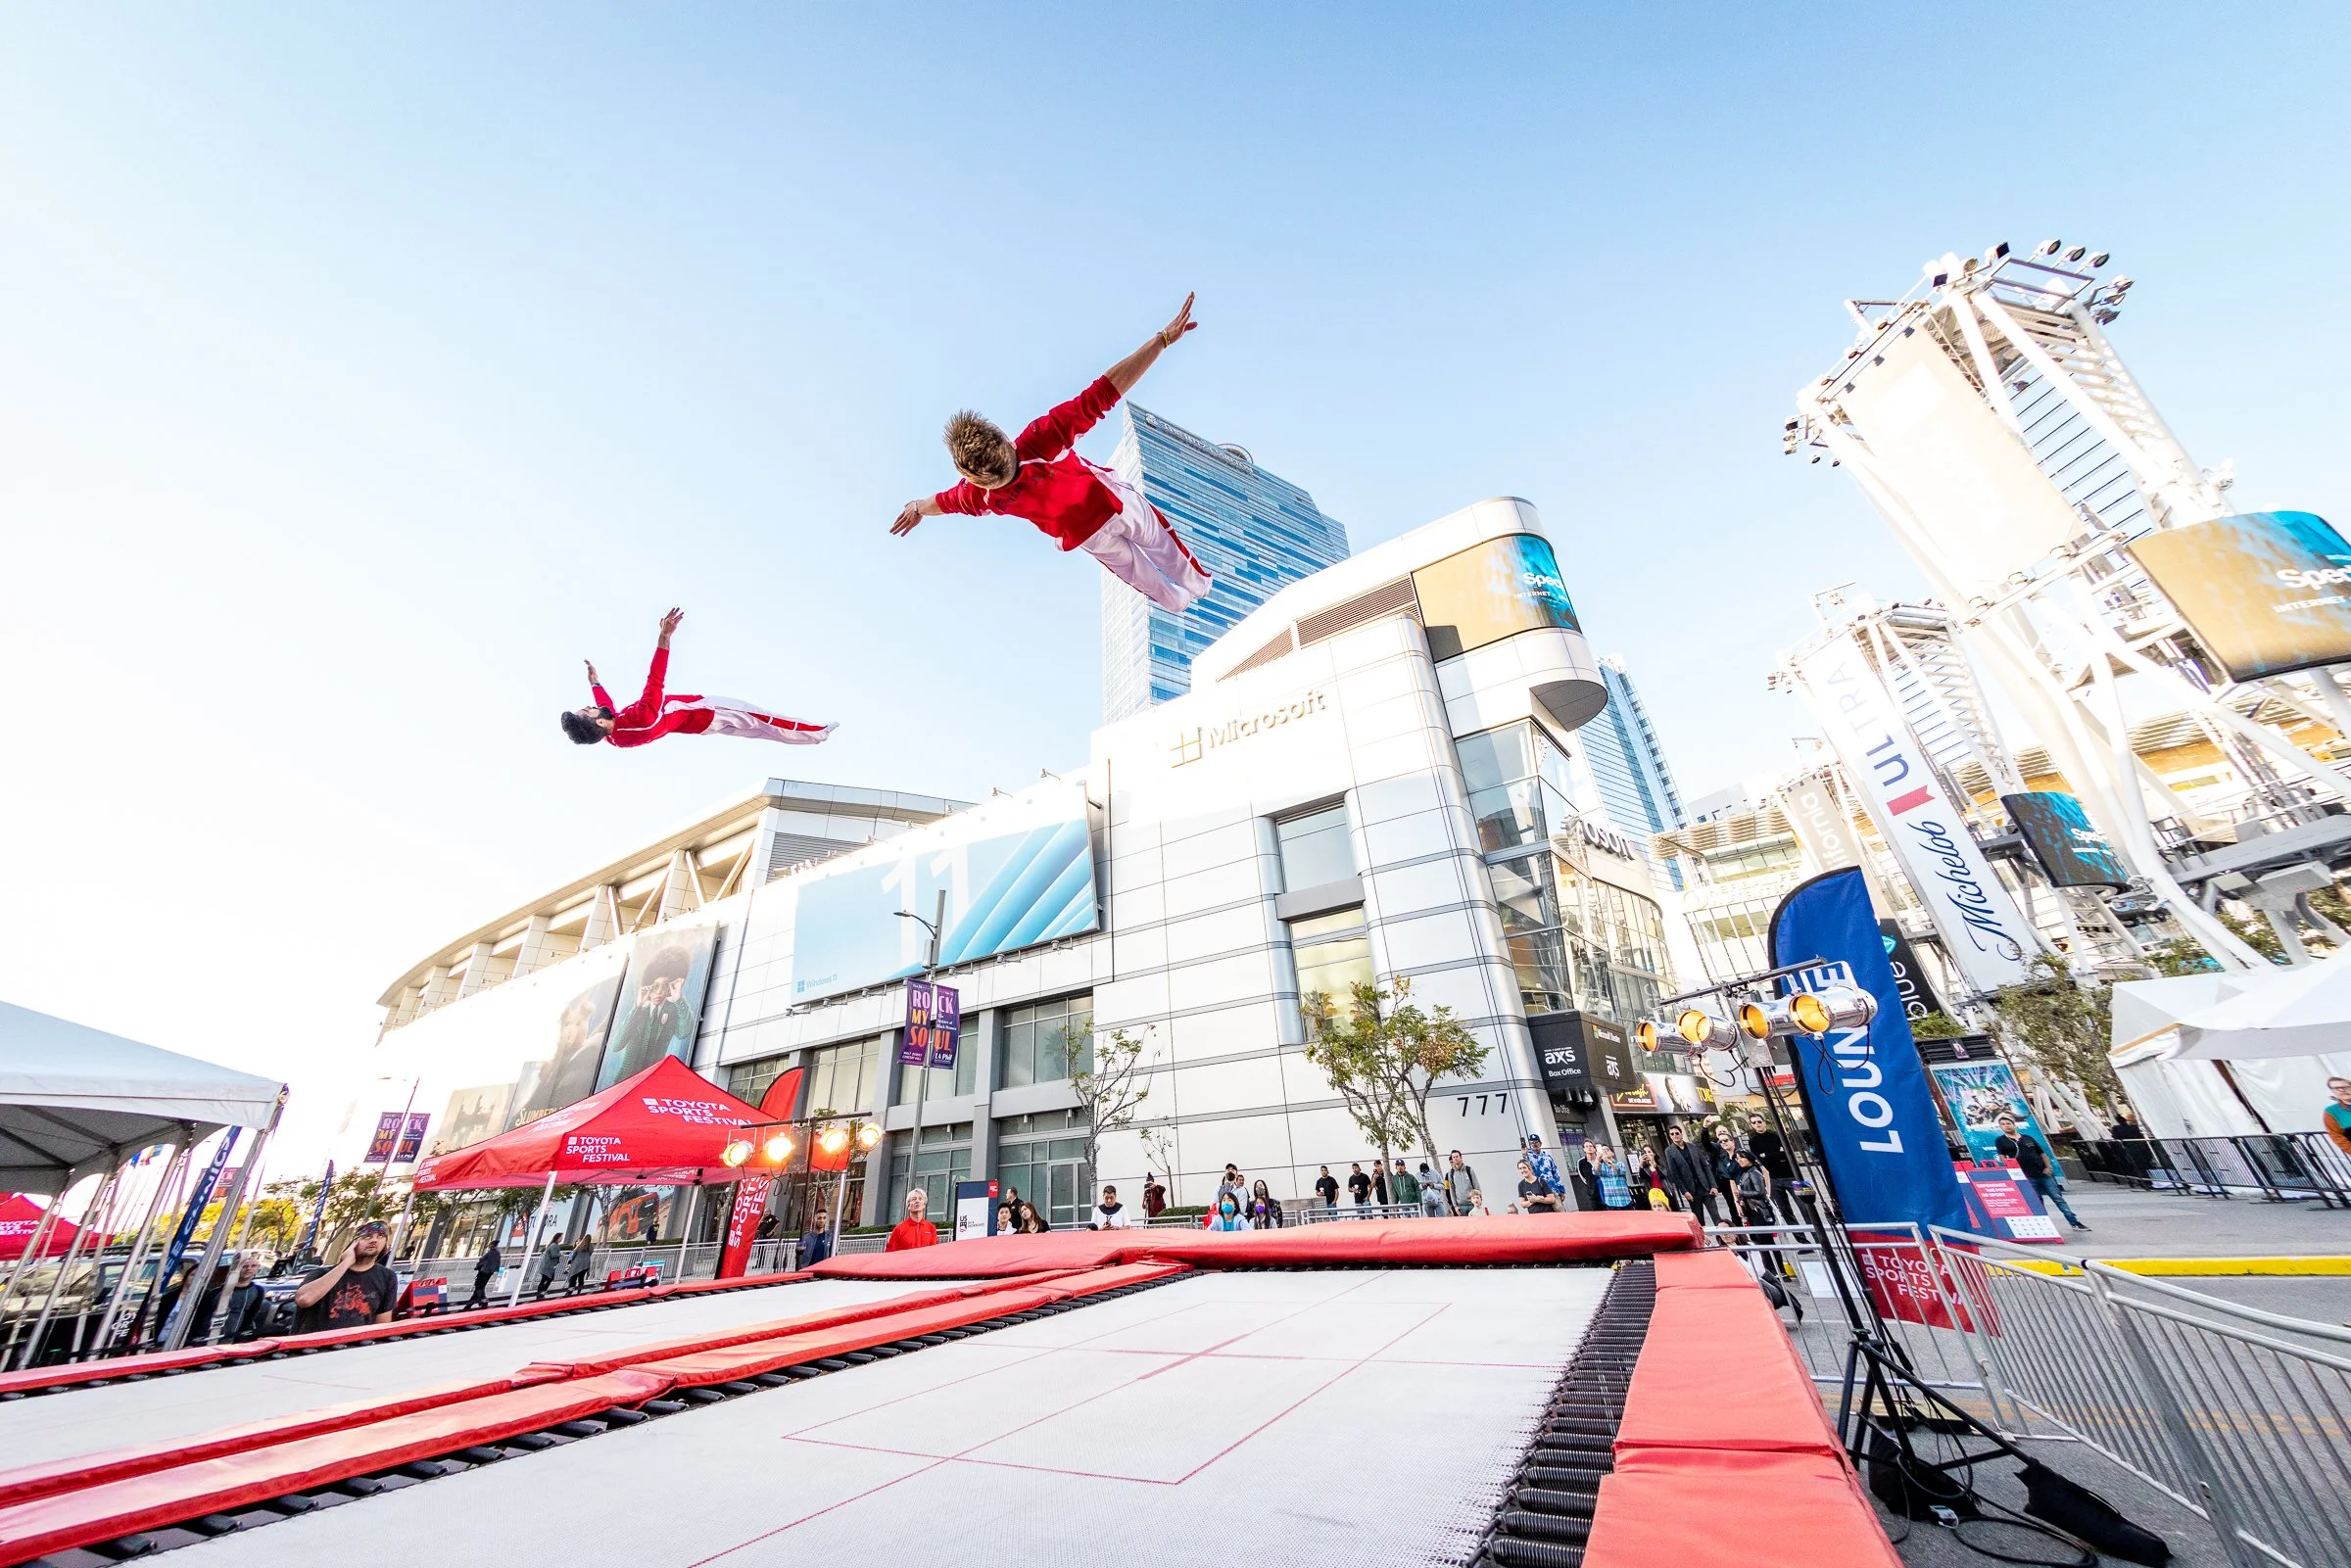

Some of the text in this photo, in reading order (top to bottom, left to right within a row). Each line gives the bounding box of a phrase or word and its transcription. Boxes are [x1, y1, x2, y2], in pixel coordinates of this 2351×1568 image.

[1210, 689, 1327, 749] Microsoft
[1906, 820, 2022, 962] Michelob
[806, 976, 833, 989] Windows
[1890, 961, 1928, 1021] blue
[911, 1009, 929, 1025] MY
[1545, 1049, 1576, 1065] axs
[1813, 967, 1904, 1154] LOUNE
[1561, 1068, 1582, 1076] Office
[1606, 1060, 1620, 1079] axs
[648, 1105, 714, 1117] SPORTS
[659, 1098, 732, 1112] TOYOTA
[1457, 1093, 1508, 1117] 777
[566, 1145, 607, 1154] SPORTS
[582, 1153, 631, 1163] FESTIVAL
[1878, 1255, 1952, 1277] TOYOA
[1865, 1265, 1932, 1287] SPORTS
